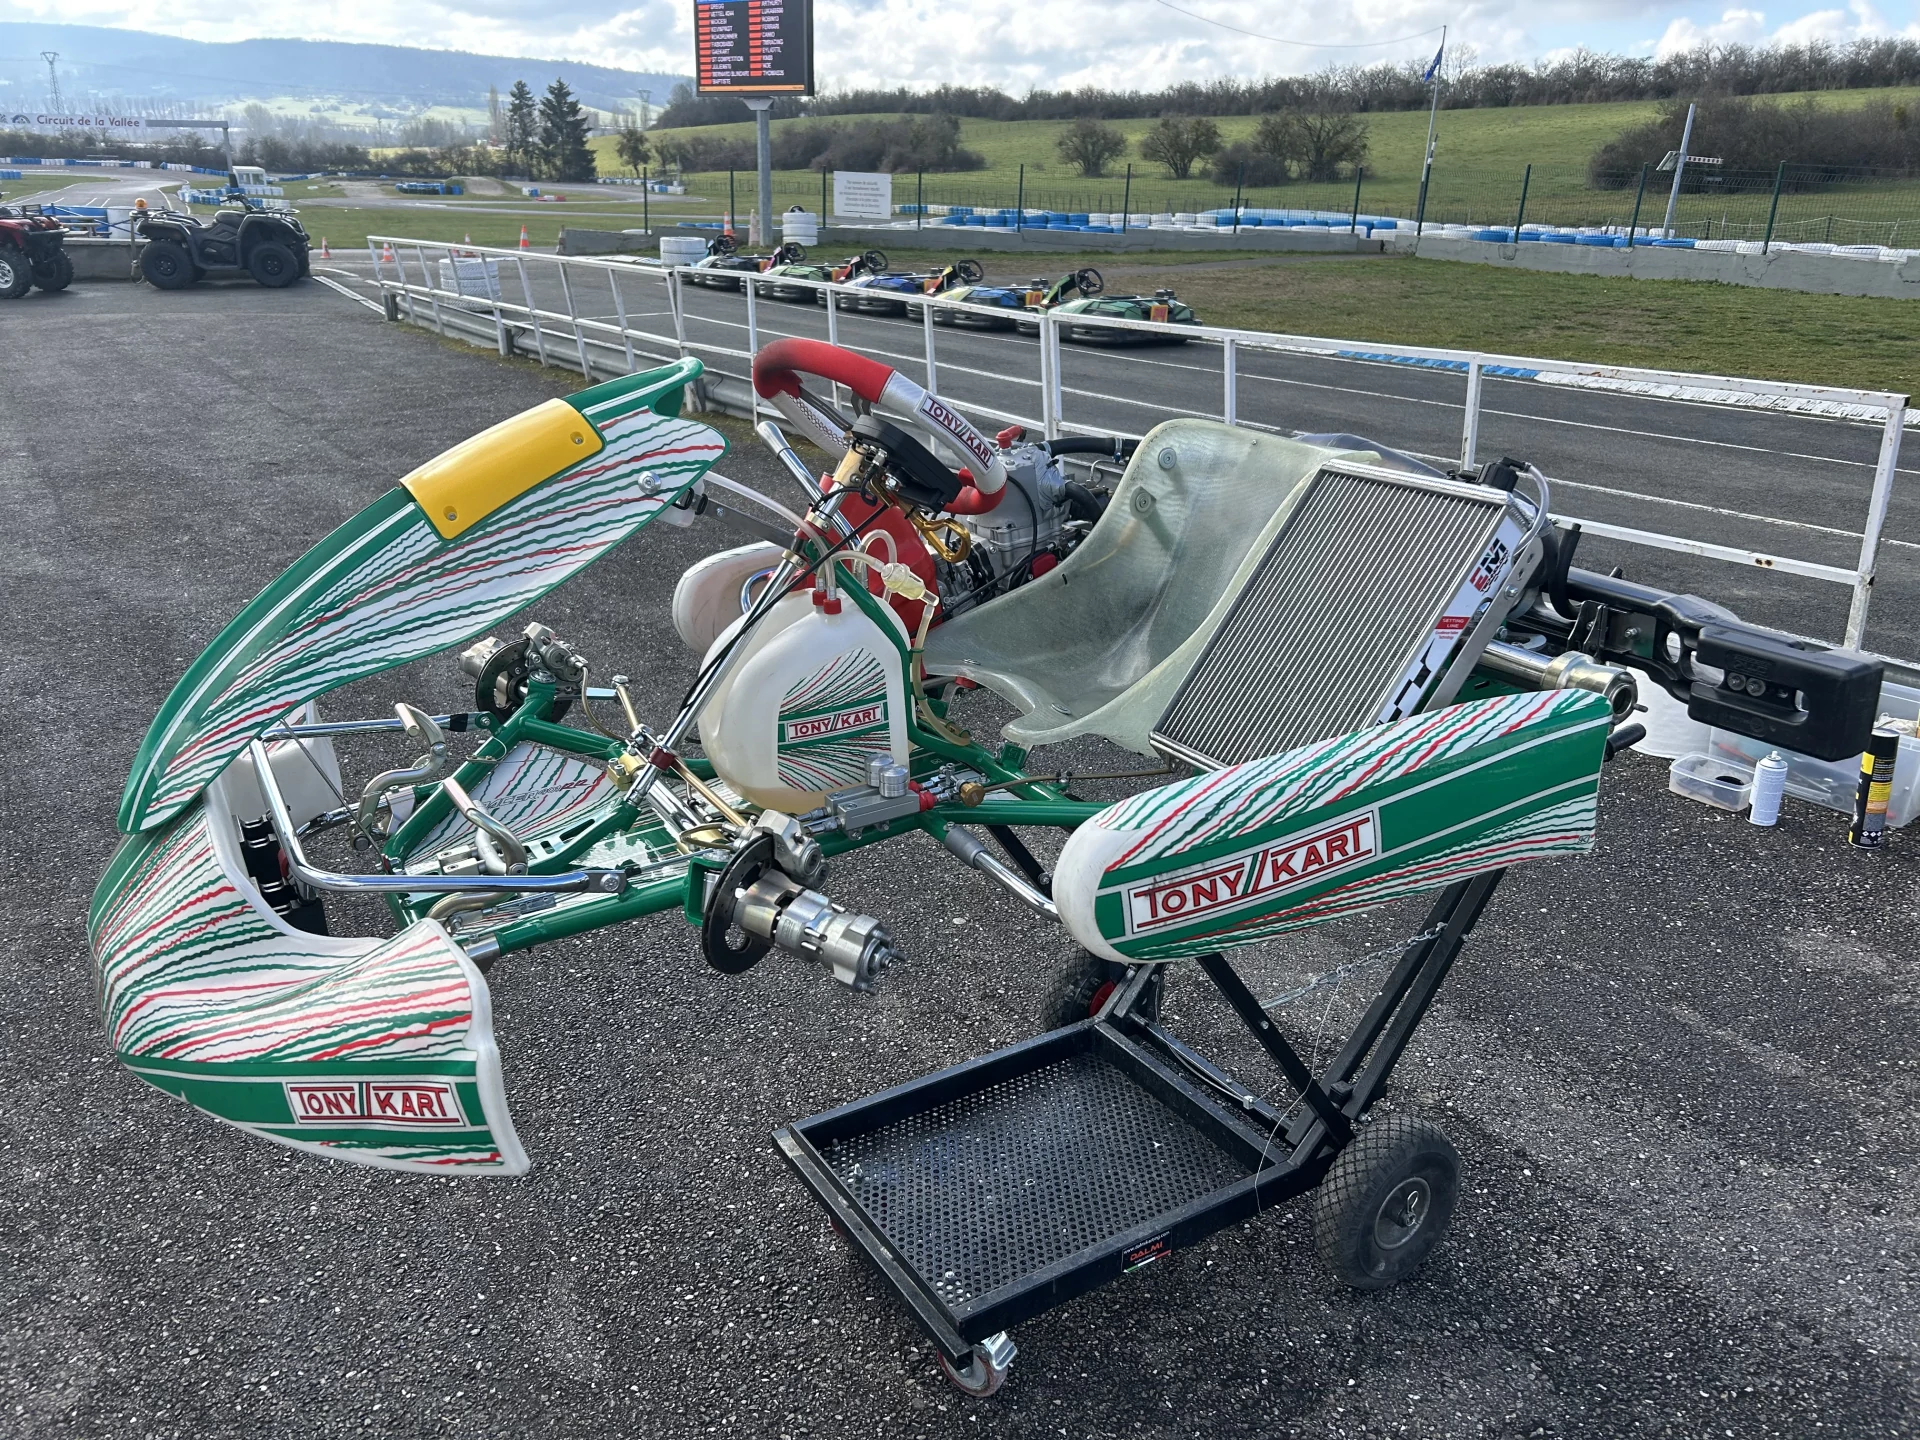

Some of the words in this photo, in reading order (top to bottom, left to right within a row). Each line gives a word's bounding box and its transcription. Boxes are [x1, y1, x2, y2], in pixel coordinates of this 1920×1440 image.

[36, 114, 75, 126] Circuit
[77, 115, 91, 126] de
[95, 116, 105, 126] la
[108, 116, 141, 128] Vallée
[789, 717, 832, 737] TONY
[840, 705, 881, 727] KART
[1133, 861, 1245, 919] TONY
[1270, 816, 1371, 883] KART
[289, 1086, 357, 1115] TONY
[371, 1085, 449, 1117] KART
[1130, 1240, 1164, 1261] DALMI
